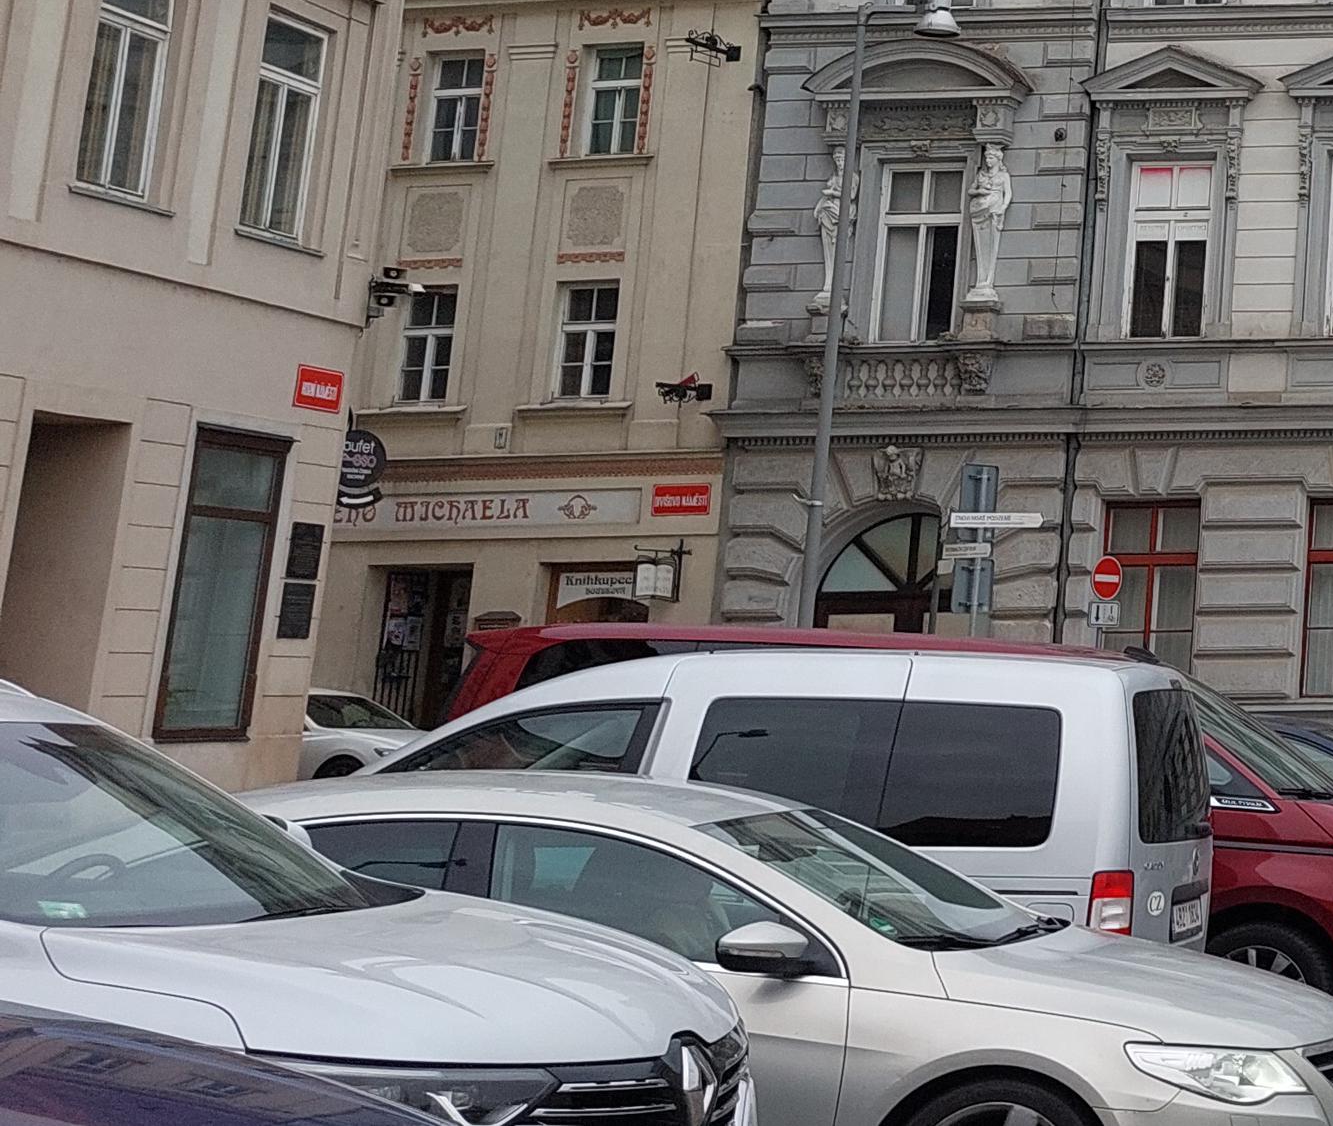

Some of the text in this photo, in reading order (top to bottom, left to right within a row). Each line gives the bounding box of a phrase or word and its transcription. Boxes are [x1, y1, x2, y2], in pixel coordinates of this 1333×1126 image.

[395, 498, 529, 525] MICHAELA
[565, 574, 633, 587] Knihkupec
[1149, 894, 1162, 913] CZ
